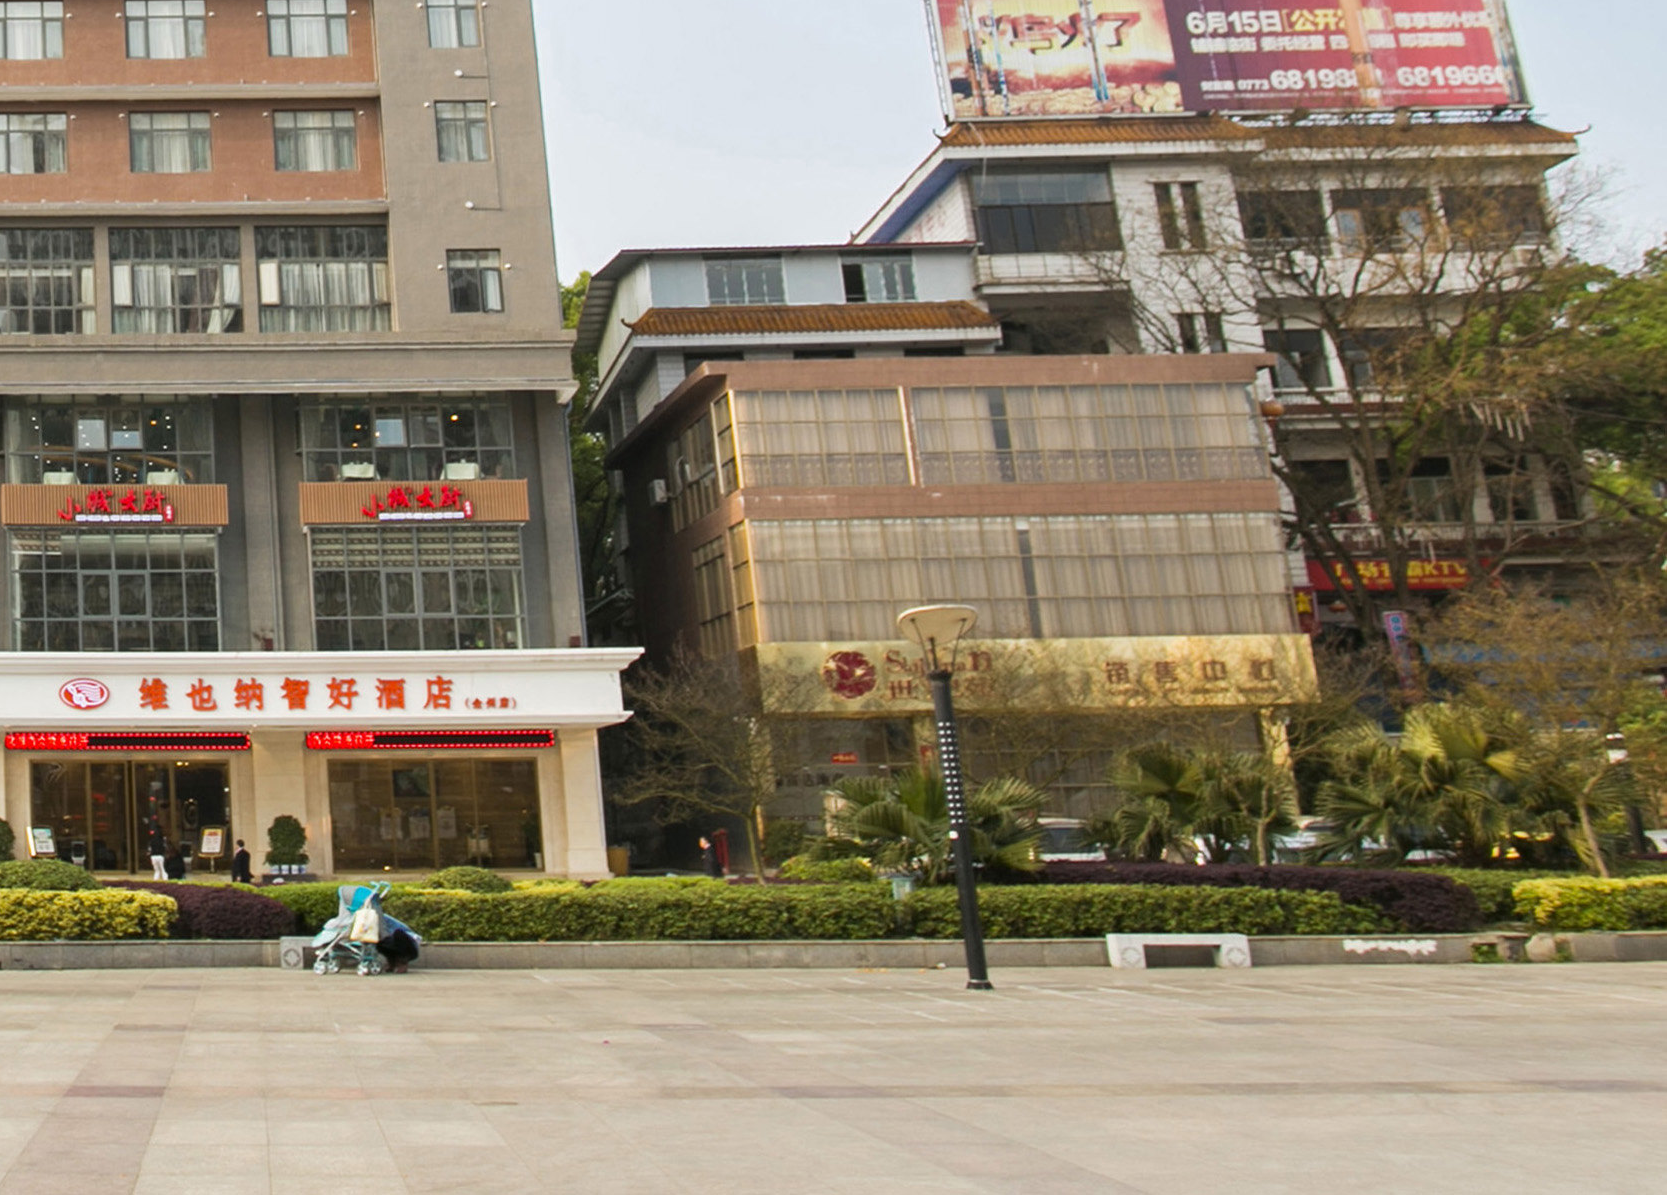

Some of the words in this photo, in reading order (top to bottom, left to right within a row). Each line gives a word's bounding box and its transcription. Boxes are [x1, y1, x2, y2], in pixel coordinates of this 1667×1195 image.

[57, 489, 165, 520] 小城大厨
[360, 485, 462, 518] 小城大厨
[138, 676, 454, 711] 维也纳智好酒店
